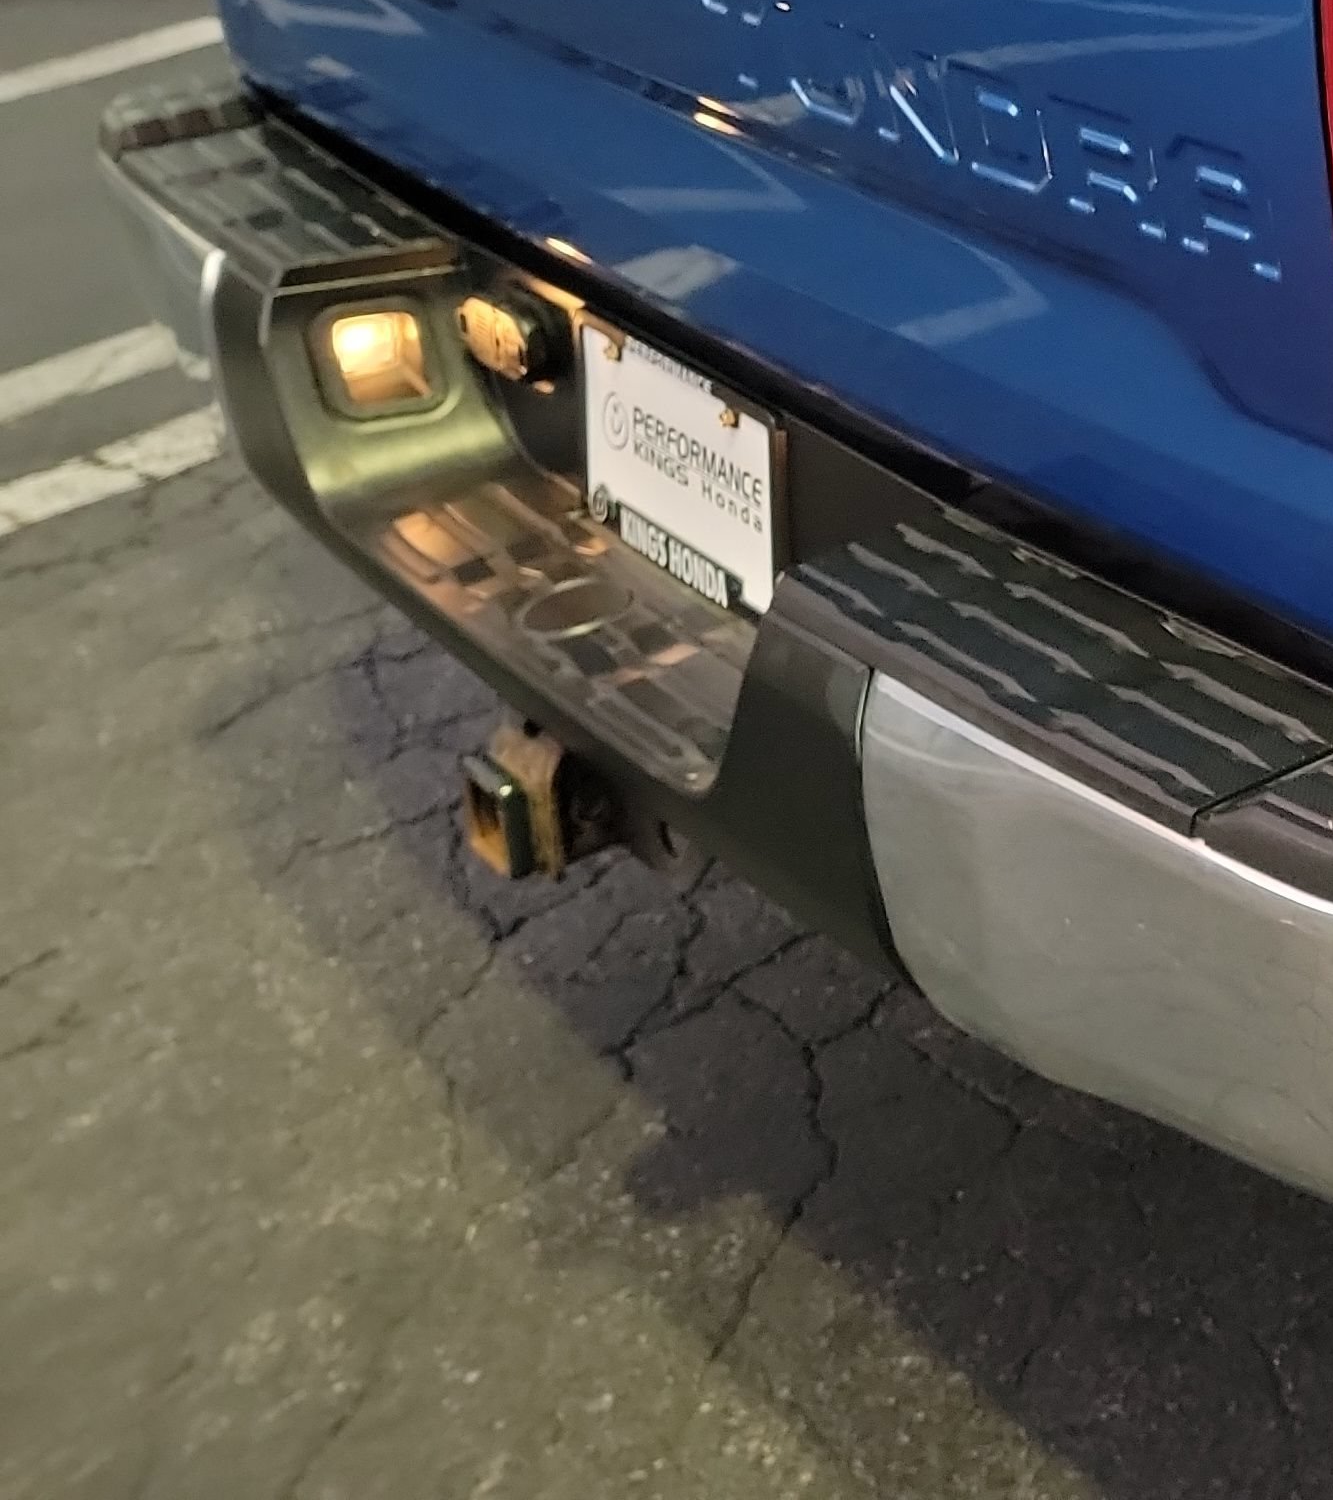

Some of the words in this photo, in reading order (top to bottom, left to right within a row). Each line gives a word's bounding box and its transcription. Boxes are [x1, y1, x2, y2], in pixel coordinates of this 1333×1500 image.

[632, 406, 764, 505] PERFORMANCE
[633, 441, 689, 487] KINGS
[701, 480, 763, 533] Honda
[620, 506, 668, 568] KINGS
[668, 536, 729, 609] HONDA
